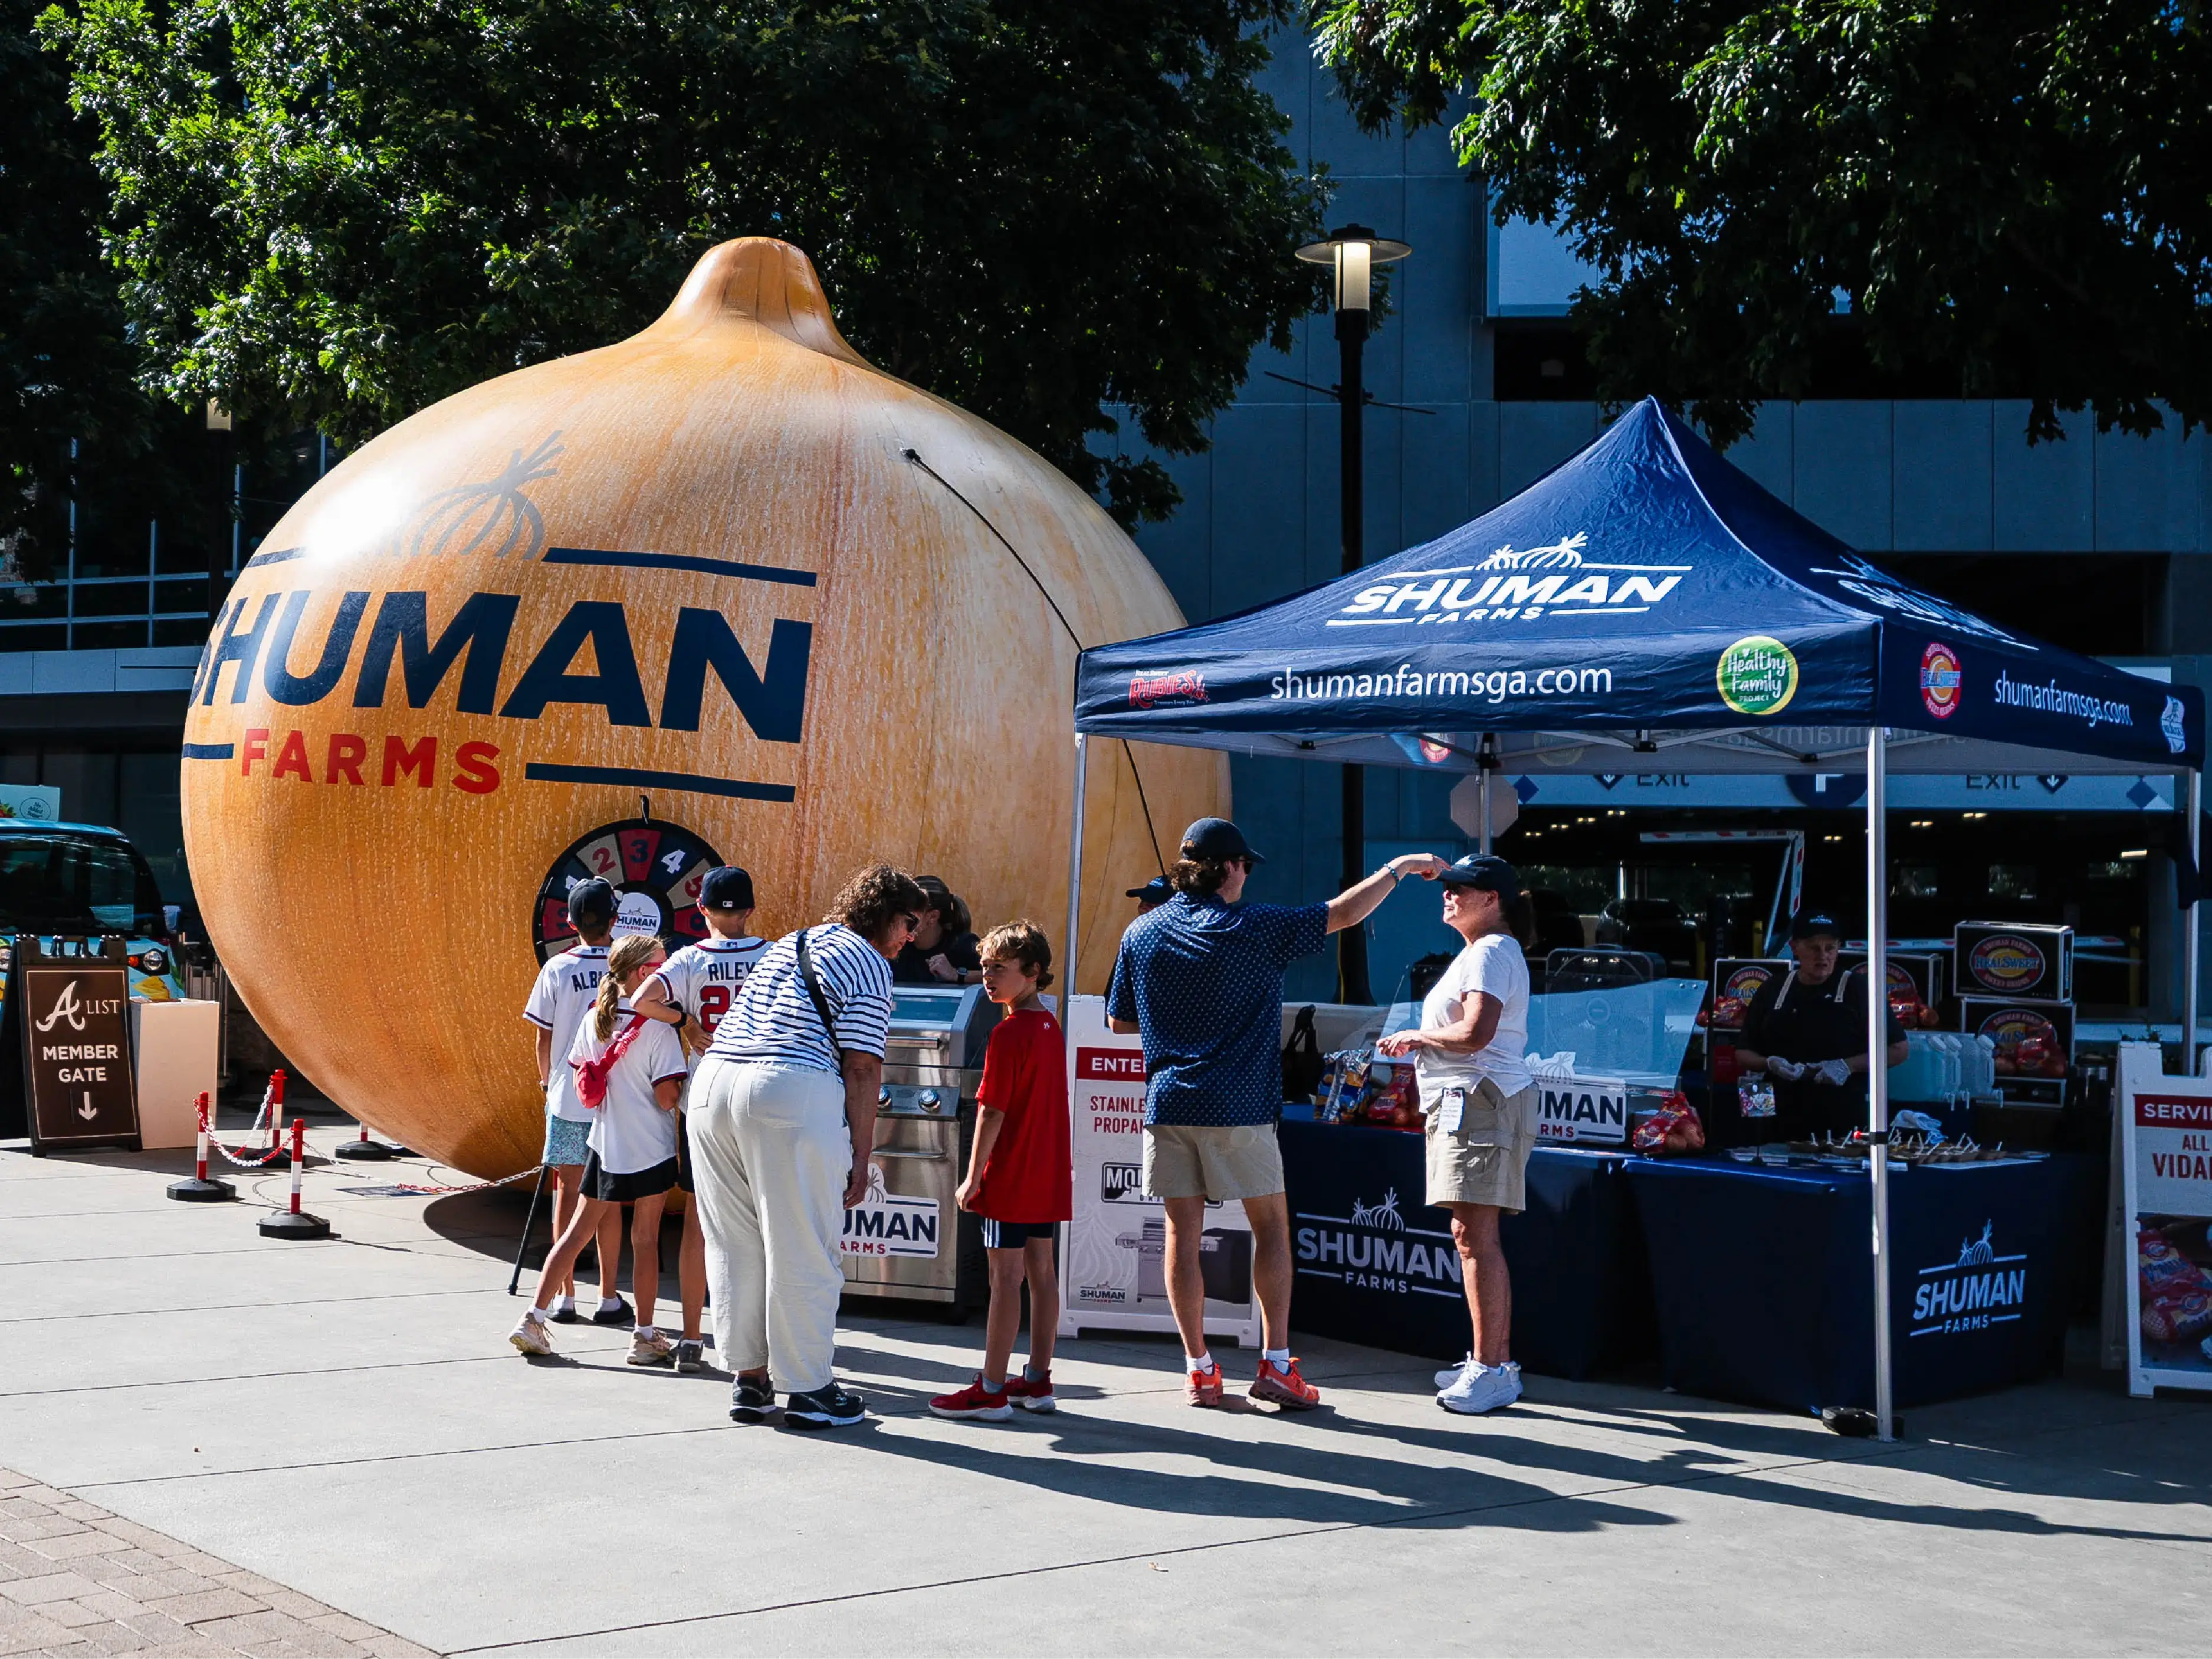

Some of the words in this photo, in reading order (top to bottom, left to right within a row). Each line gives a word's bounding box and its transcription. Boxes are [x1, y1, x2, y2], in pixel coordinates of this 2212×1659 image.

[1341, 575, 1683, 612] SHUMAN
[1416, 606, 1543, 625] FARMS
[1727, 648, 1787, 677] Healthy
[1271, 663, 1612, 704] shumanfarmsga.com
[1732, 670, 1781, 698] Family
[1995, 669, 2133, 727] shumanfarmsga.com
[241, 728, 501, 794] FARMS
[592, 848, 616, 874] 2
[629, 840, 648, 863] 3
[661, 849, 686, 874] 4
[617, 916, 657, 928] HUMAN
[708, 961, 756, 982] RILEY
[37, 980, 85, 1031] A
[86, 999, 120, 1014] LIST
[42, 1044, 119, 1061] MEMBER
[58, 1067, 107, 1083] GATE
[1091, 1057, 1147, 1073] ENTE
[1089, 1095, 1146, 1113] STAINLE
[1538, 1090, 1623, 1126] MAN
[2144, 1103, 2212, 1121] SERVI
[1093, 1116, 1144, 1135] PROPA
[1540, 1123, 1574, 1138] RMS
[2182, 1134, 2210, 1152] ALL
[840, 1240, 885, 1255] ARMS
[1298, 1227, 1461, 1284] SHUMAN
[1345, 1271, 1408, 1294] FARMS
[1080, 1290, 1125, 1300] SHUMAN
[1912, 1269, 2026, 1320] SHUMAN
[1944, 1314, 1989, 1334] FARMS
